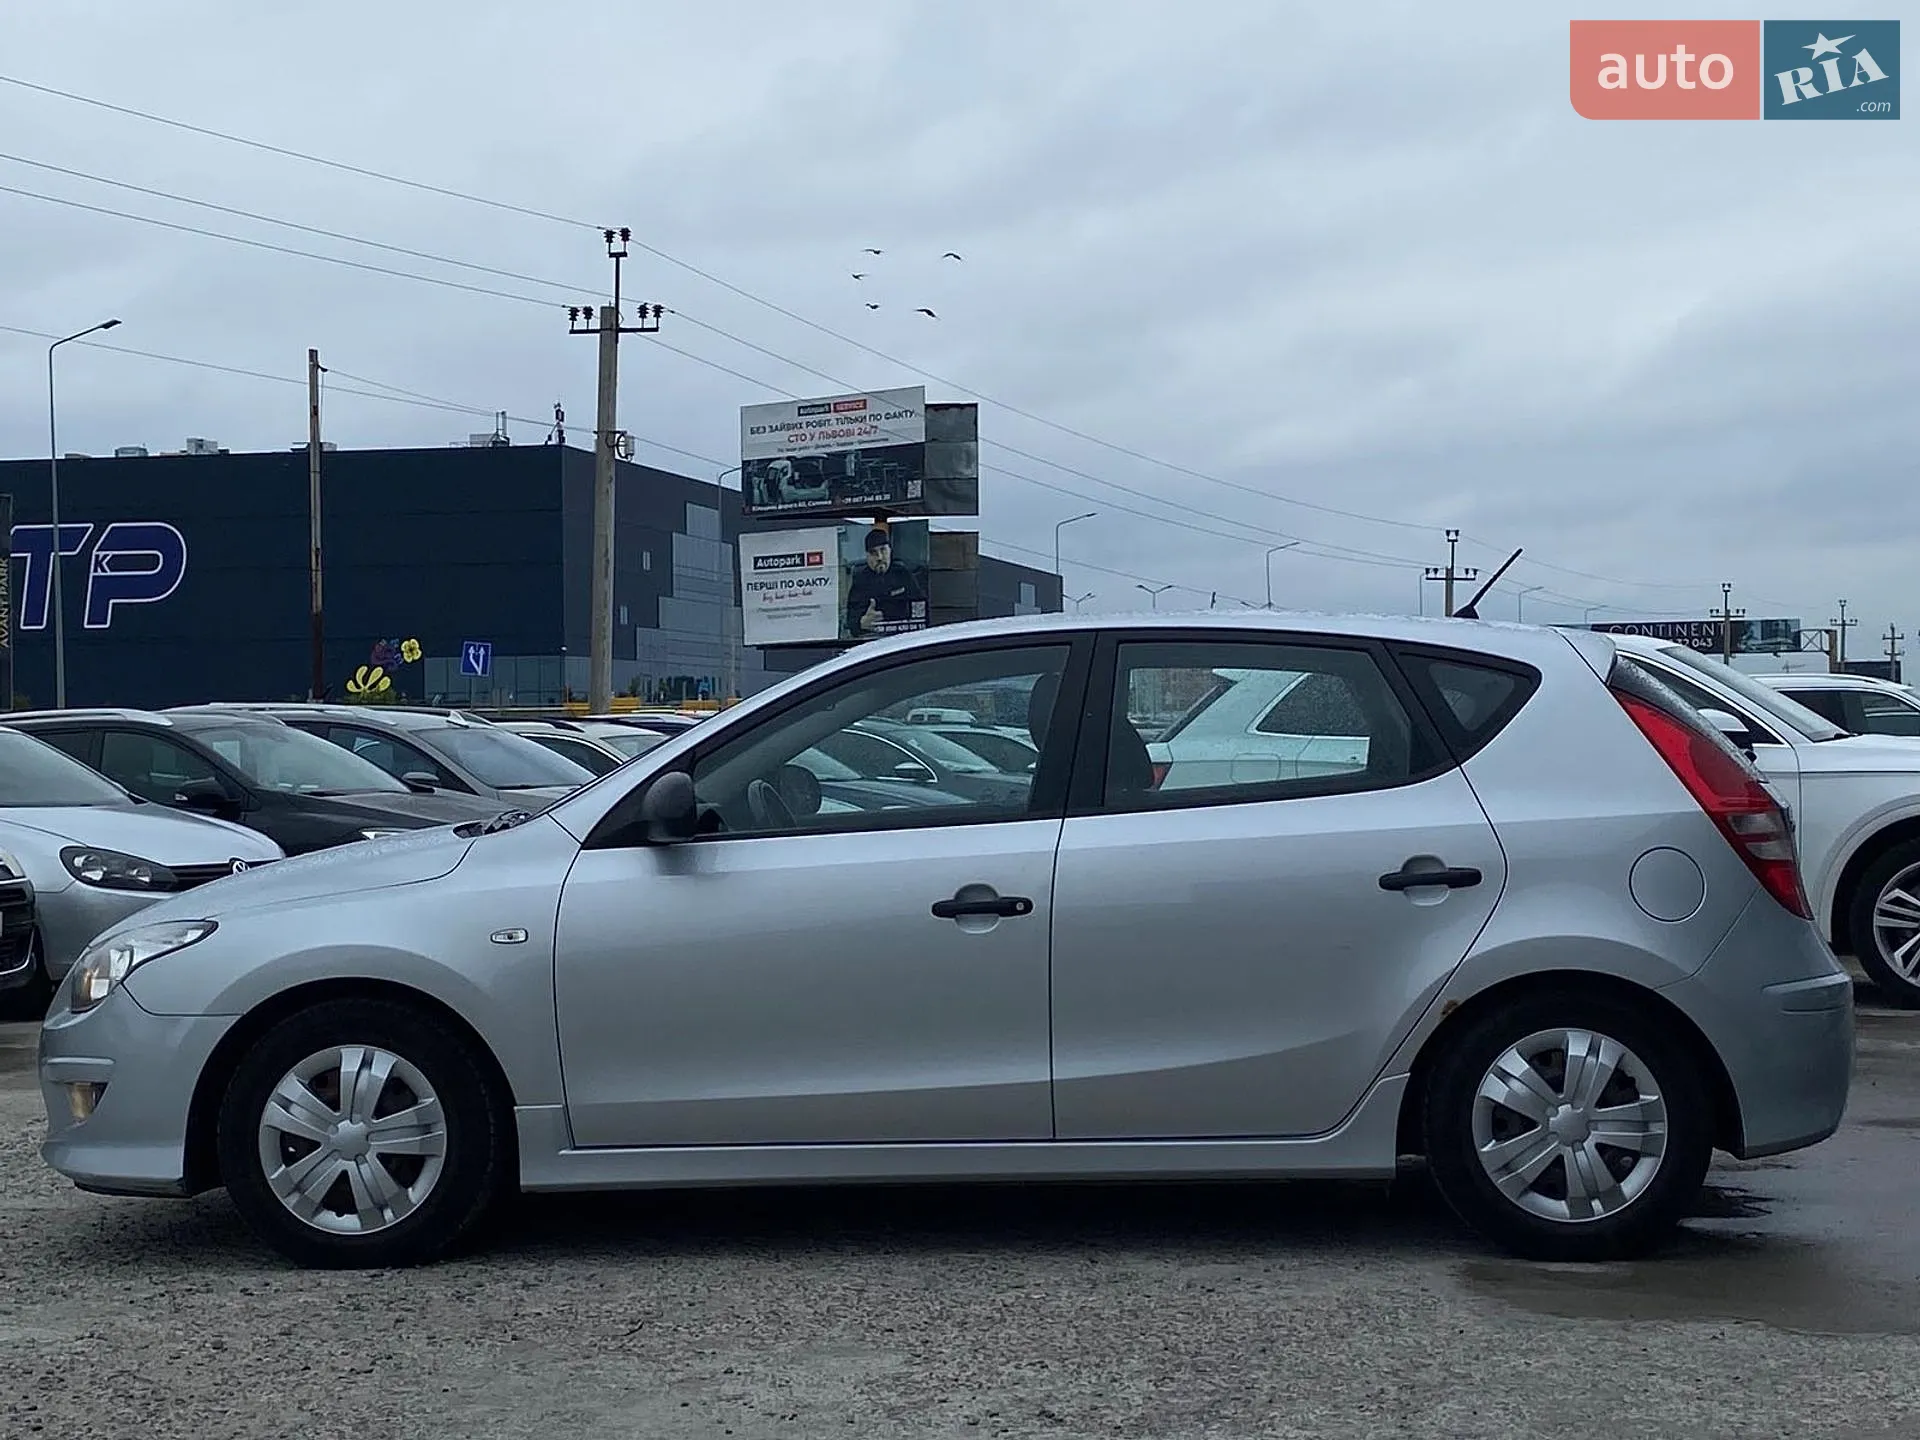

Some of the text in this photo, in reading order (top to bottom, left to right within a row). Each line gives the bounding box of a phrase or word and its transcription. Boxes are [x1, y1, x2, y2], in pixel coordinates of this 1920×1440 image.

[750, 425, 767, 435] БЕЗ
[868, 414, 883, 423] ПО
[787, 432, 808, 443] СТО
[755, 554, 802, 568] Autopark
[746, 581, 779, 592] ПЕРШІ
[780, 579, 795, 590] ПО
